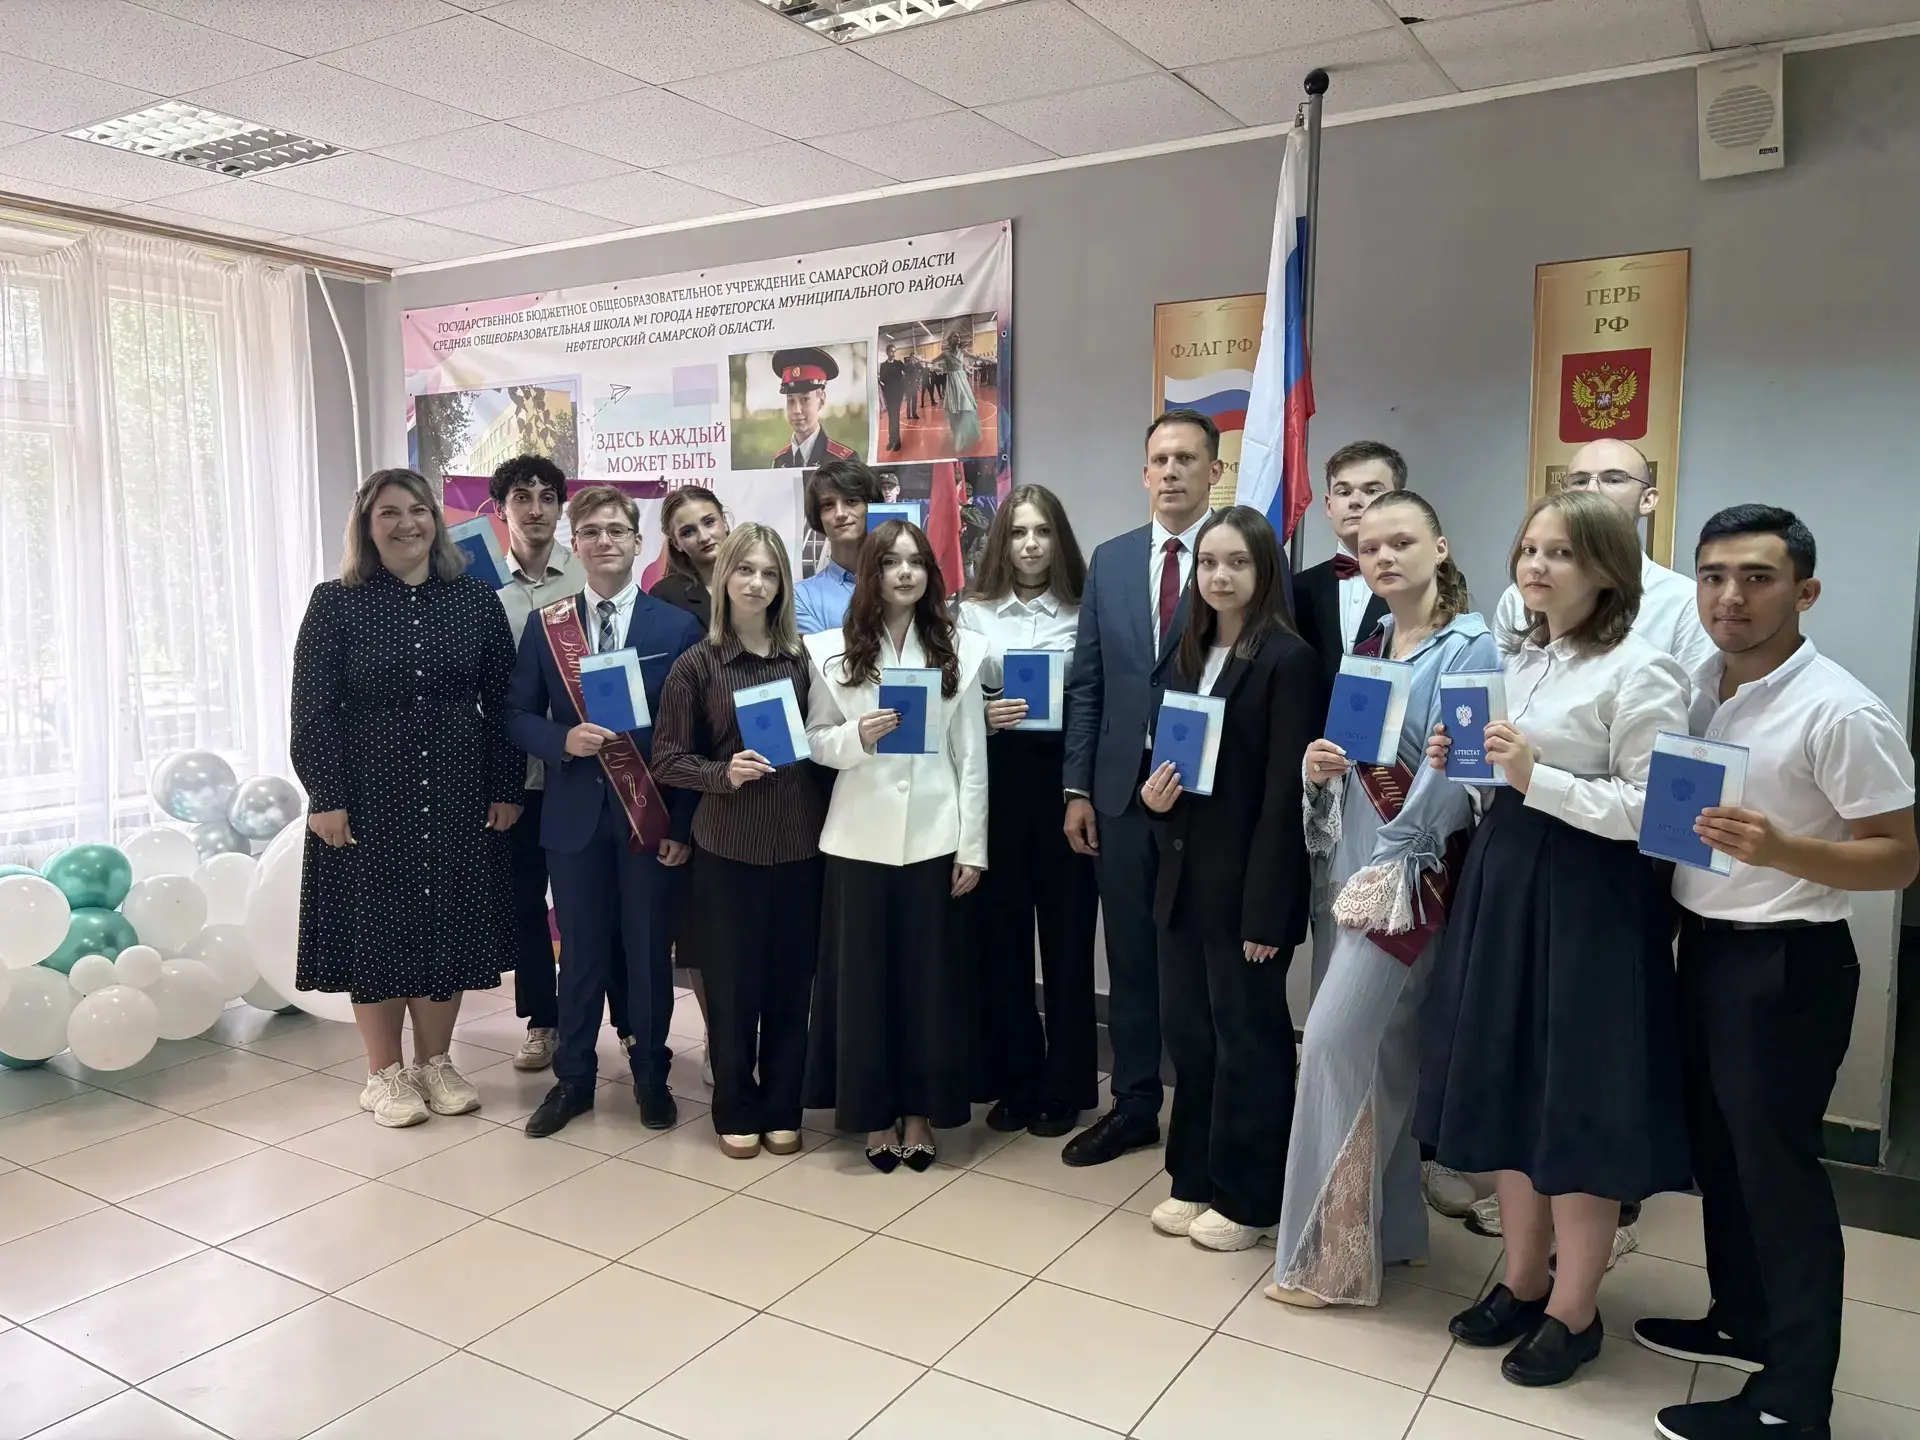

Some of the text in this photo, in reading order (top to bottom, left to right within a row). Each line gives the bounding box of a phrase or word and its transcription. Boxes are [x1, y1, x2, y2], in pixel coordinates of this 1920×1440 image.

[438, 251, 956, 333] ГОСУДАРСТВЕННОЕ БЮДЖЕТНОЕ ОБЩЕОБРАЗОВАТЕЛЬНОЕ УЧРЕЖДЕНИЕ САМАРСКОЙ ОБЛАСТИ
[1584, 285, 1641, 307] ГЕРБ
[433, 272, 964, 351] СРЕДНЯЯ ОБЩЕОБРАЗОВАТЕЛЬНАЯ ШКОЛА №1 ГОРОДА НЕФТЕГОРСКА МУНИЦИПАЛЬНОГО РАЙОНА
[1593, 315, 1629, 335] РФ
[565, 318, 775, 353] НЕФТЕГОРСКИЙ САМАРСКОЙ ОБЛАСТИ.
[1170, 337, 1254, 359] ФЛАГ РФ
[596, 421, 727, 453] ЗДЕСЬ КАЖДЫЙ
[606, 451, 717, 474] МОЖЕТ БЫТЬ
